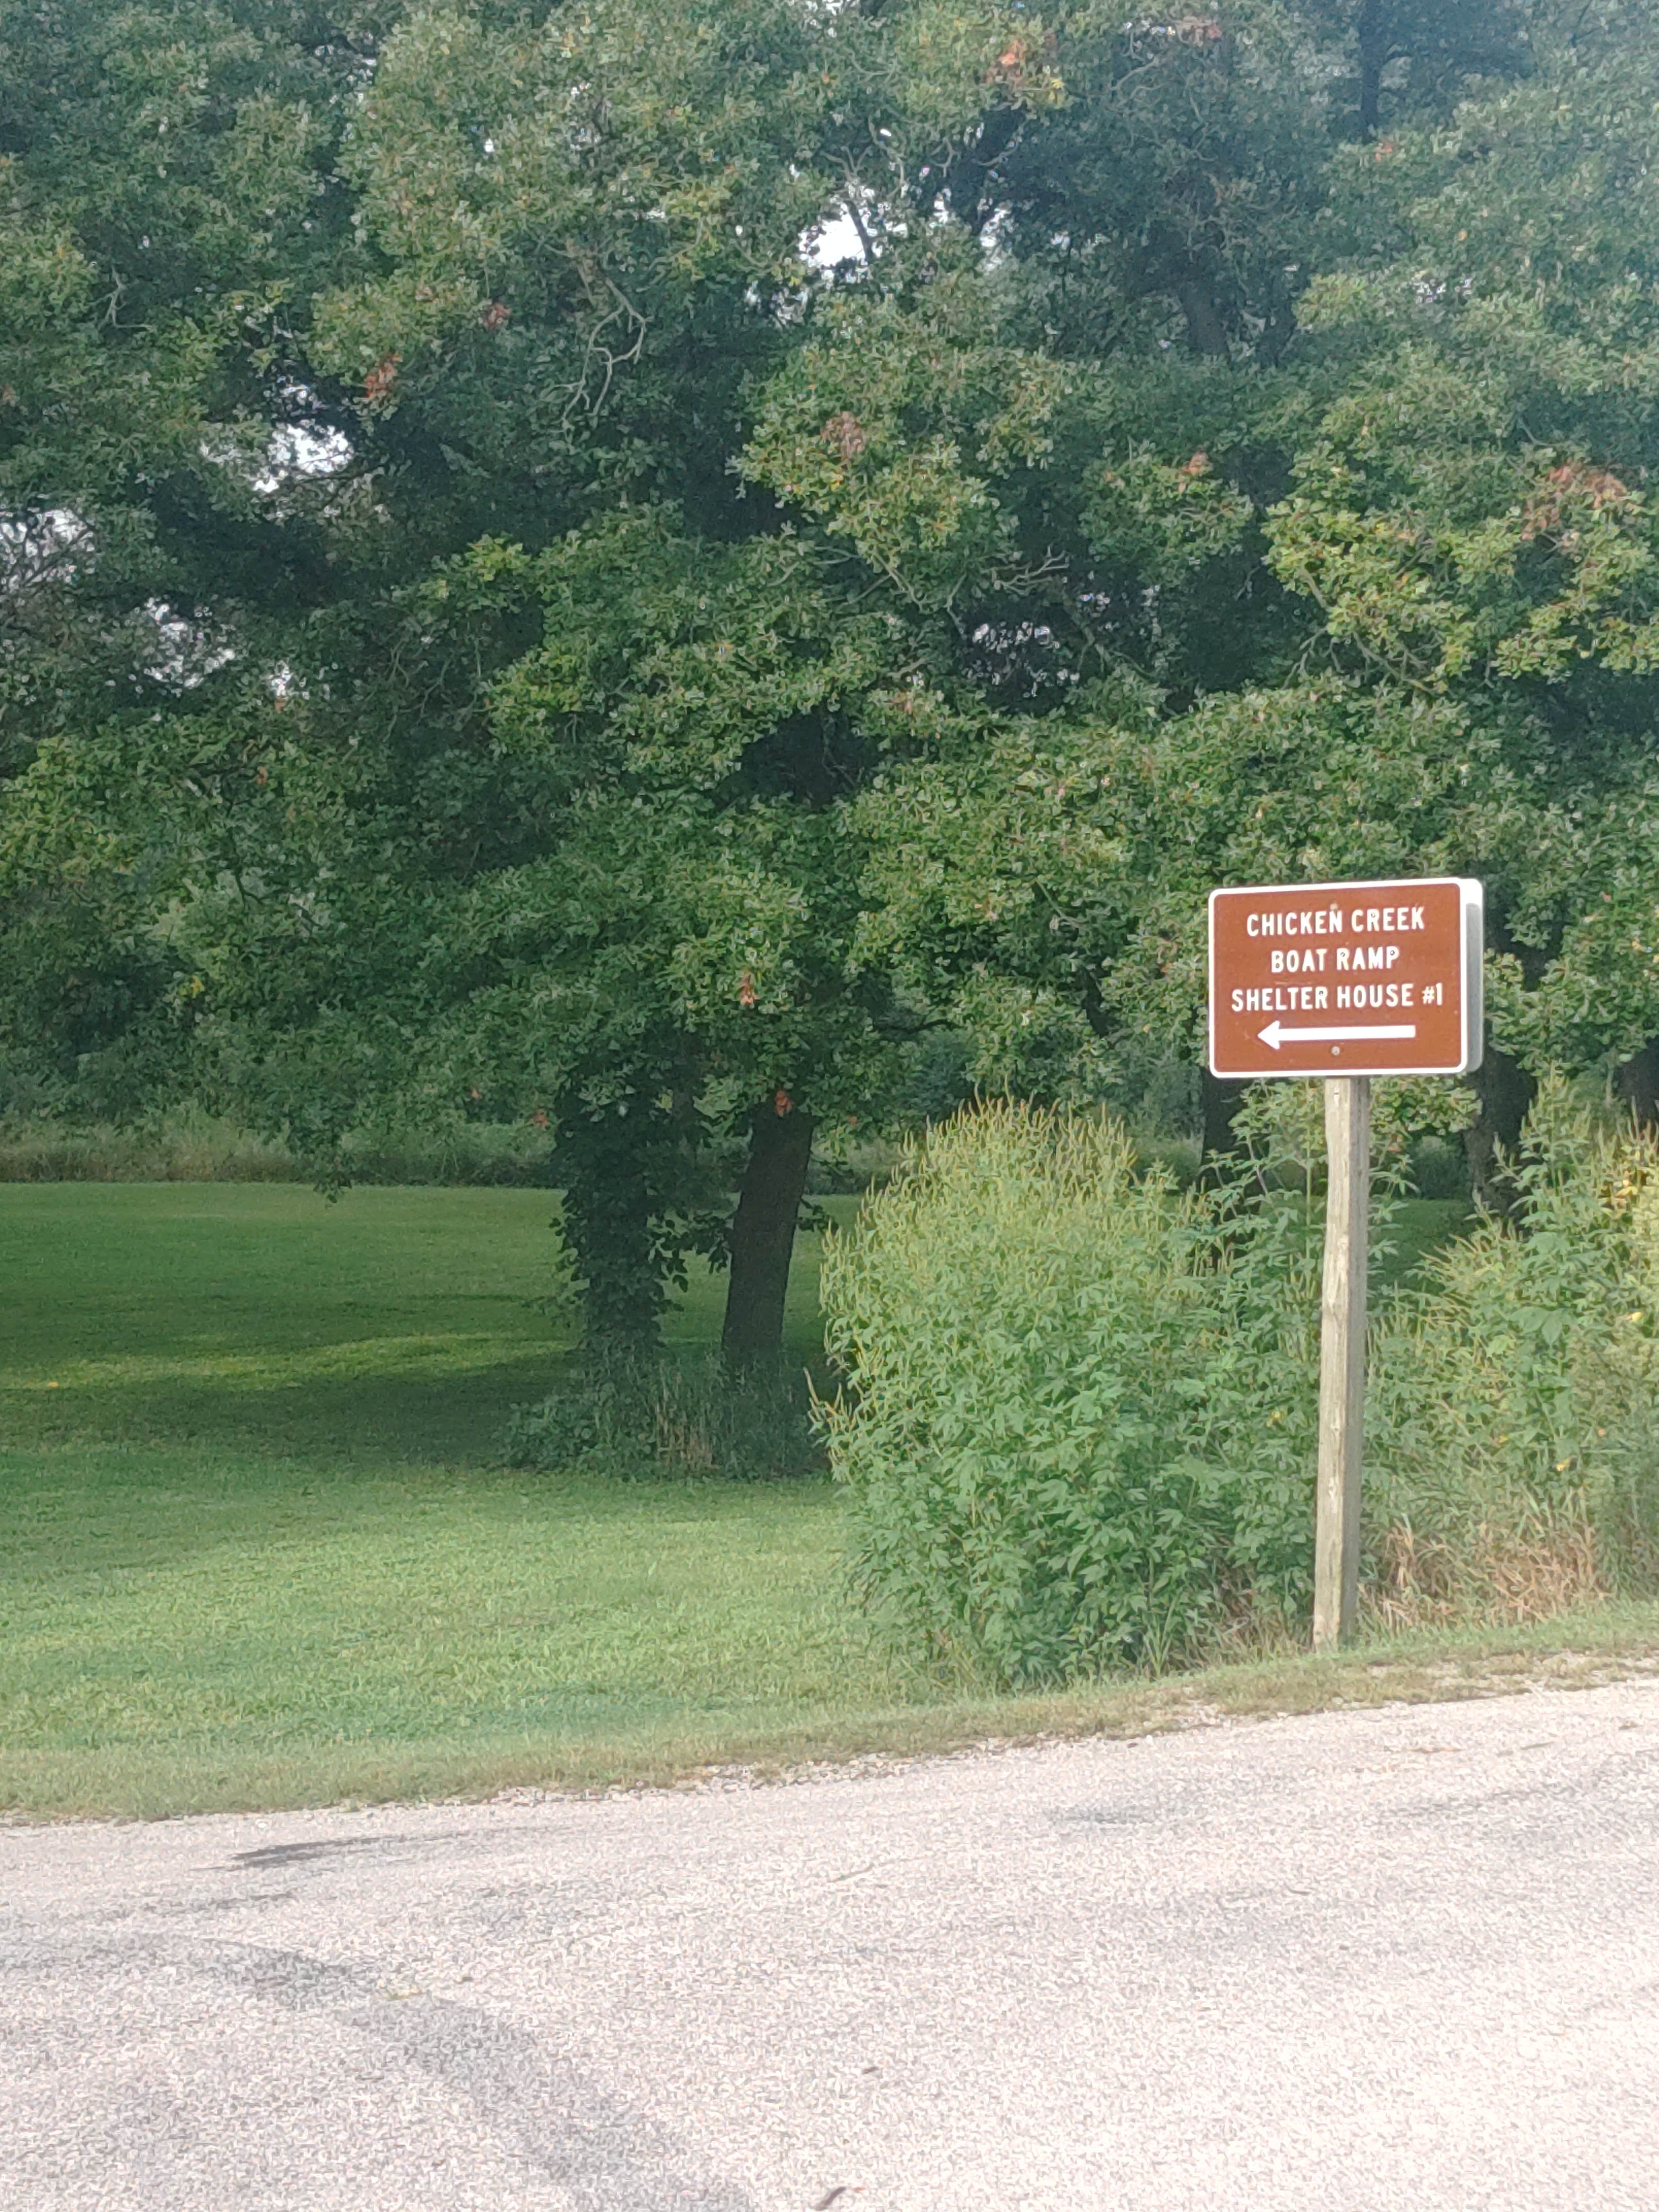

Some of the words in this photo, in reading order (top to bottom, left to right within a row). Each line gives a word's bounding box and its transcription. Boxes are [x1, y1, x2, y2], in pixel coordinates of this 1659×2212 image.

[1247, 910, 1343, 937] CHICKEN
[1351, 906, 1425, 932] CREEK
[1271, 948, 1327, 973] BOAT
[1336, 945, 1400, 971] RAMP
[1231, 986, 1328, 1012] SHELTER
[1337, 983, 1414, 1009] HOUSE
[1422, 983, 1443, 1006] #1
